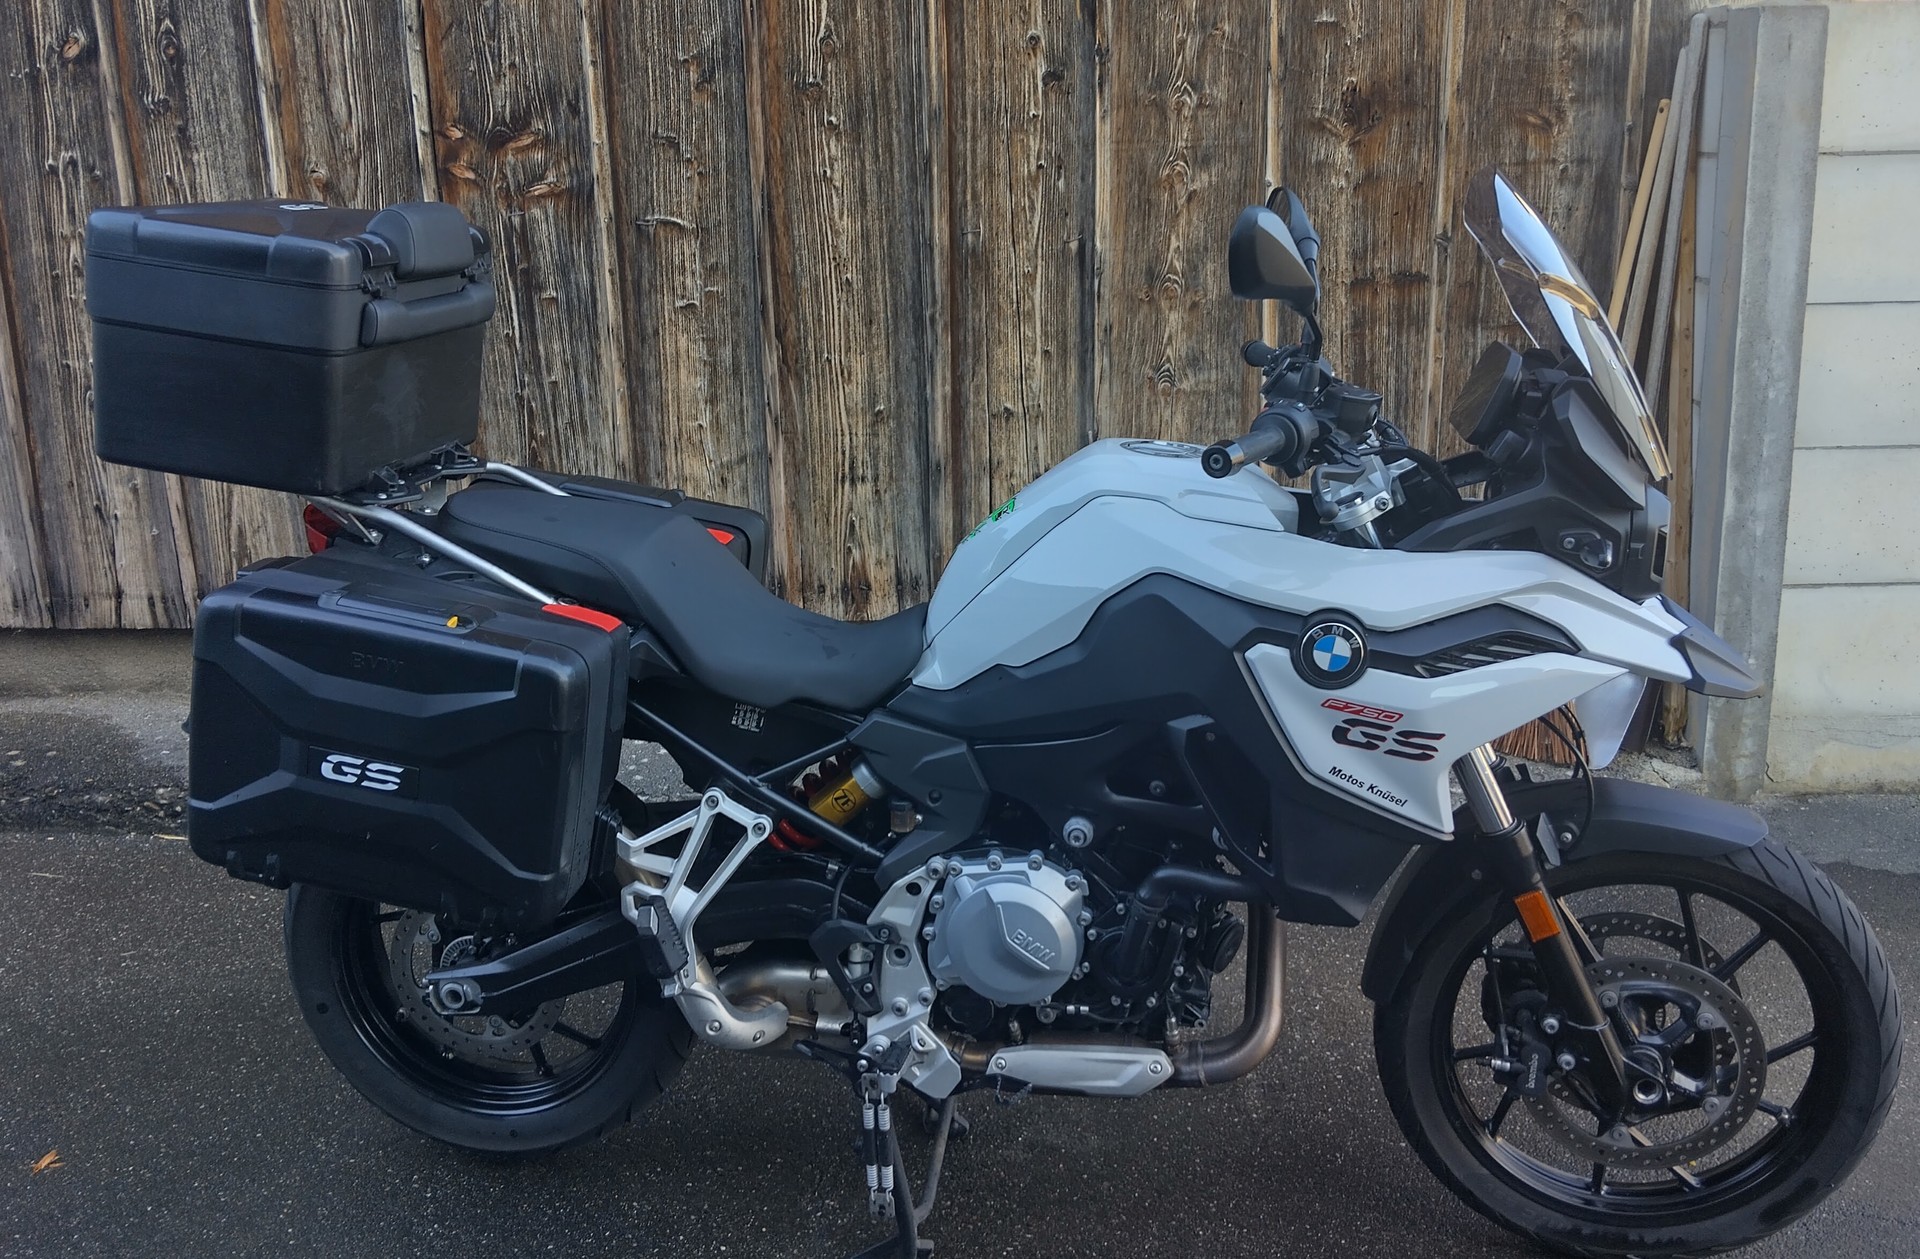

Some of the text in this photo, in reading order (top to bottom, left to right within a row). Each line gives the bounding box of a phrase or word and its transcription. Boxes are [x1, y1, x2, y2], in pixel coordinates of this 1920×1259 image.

[1312, 626, 1359, 649] BMW
[1324, 699, 1400, 722] F750
[1331, 717, 1446, 761] GS
[320, 753, 404, 791] GS
[1328, 765, 1408, 808] Motos Knüsel
[832, 789, 855, 812] ZF
[1010, 928, 1056, 962] BMW
[1525, 1053, 1539, 1089] brembo
